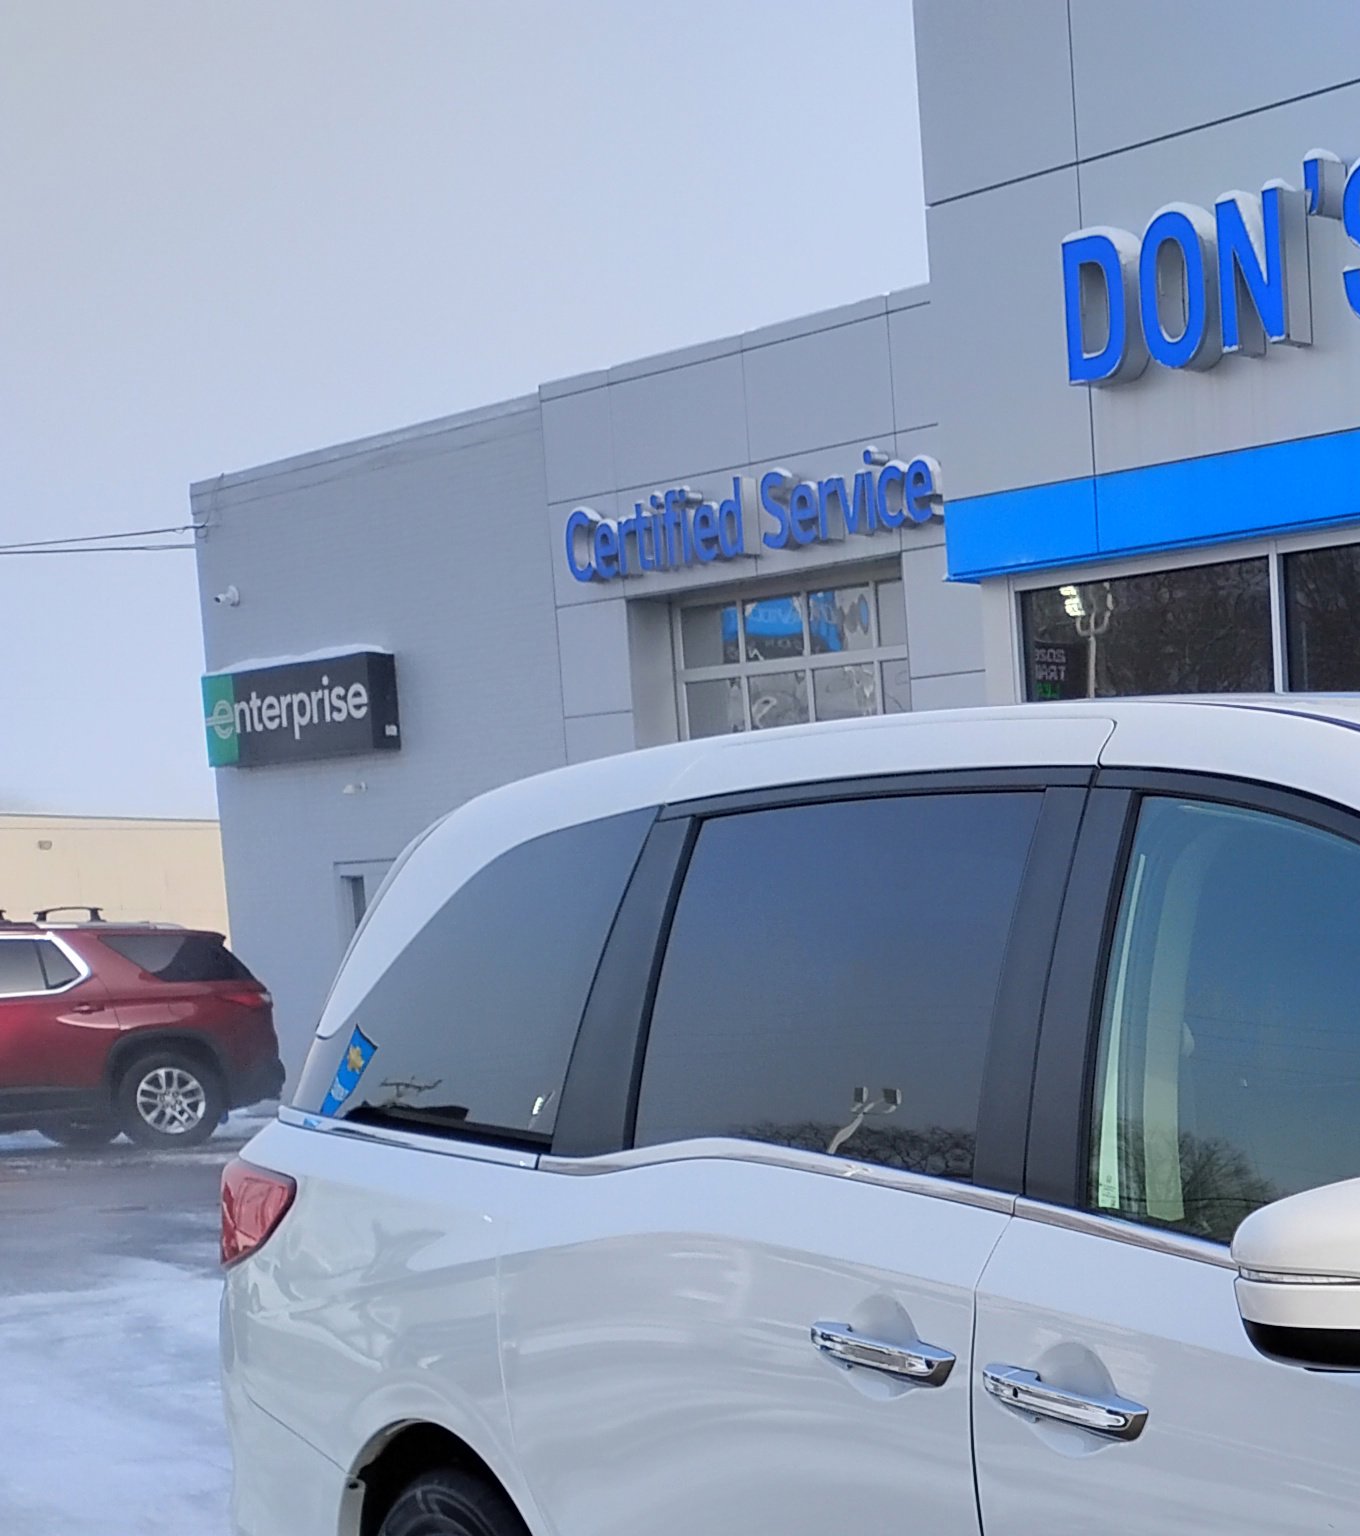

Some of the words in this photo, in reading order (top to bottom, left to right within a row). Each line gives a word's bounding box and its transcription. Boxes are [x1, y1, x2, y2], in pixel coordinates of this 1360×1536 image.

[566, 476, 748, 582] Certified
[760, 447, 938, 550] Service
[206, 675, 368, 740] enterprise
